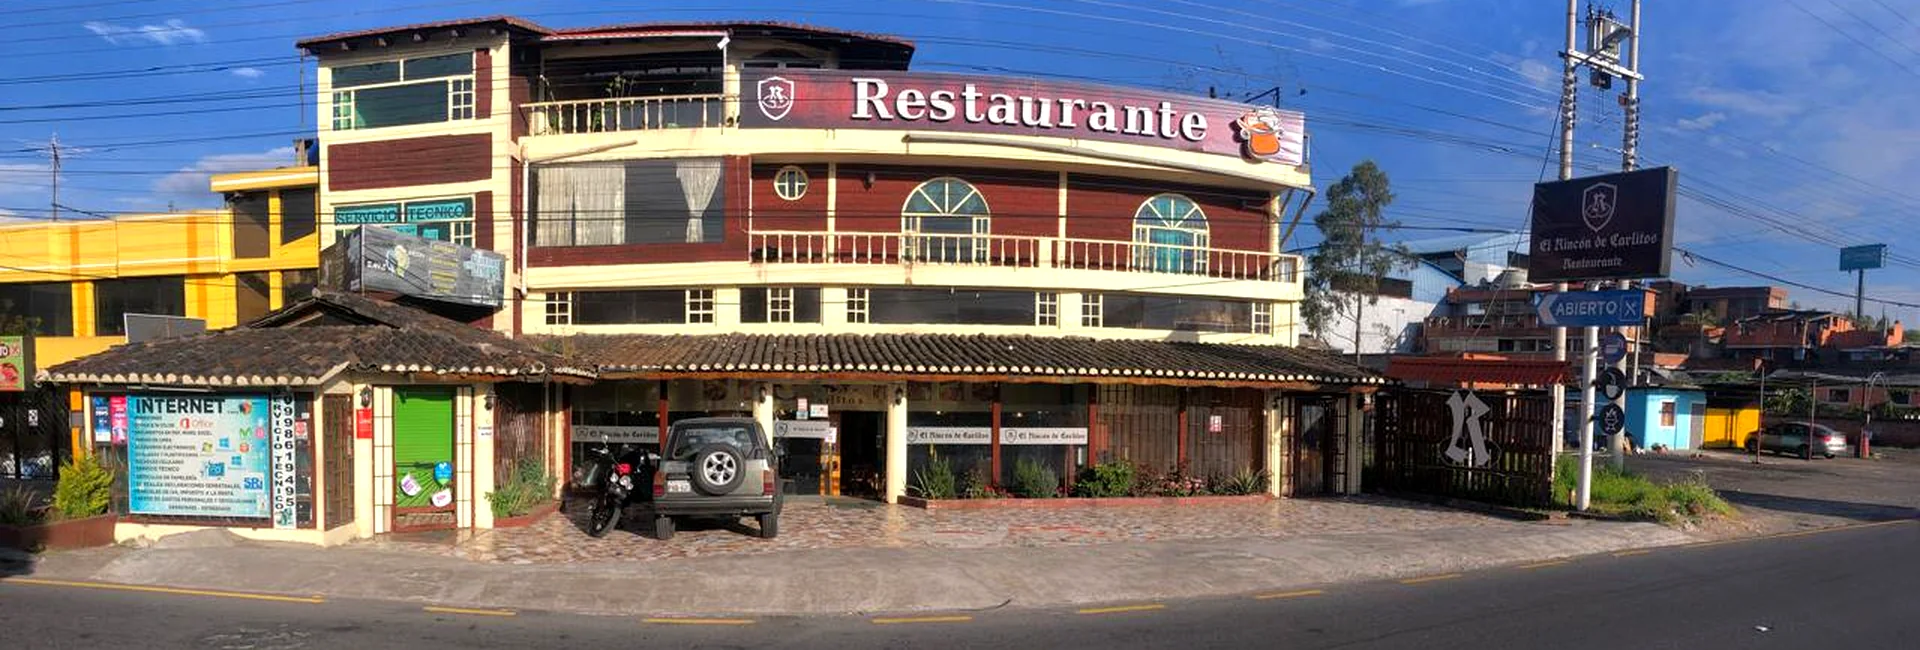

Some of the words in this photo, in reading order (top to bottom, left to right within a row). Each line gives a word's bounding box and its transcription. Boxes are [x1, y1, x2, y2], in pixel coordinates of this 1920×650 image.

[851, 77, 1208, 141] Restaurante
[336, 210, 397, 223] SERVICIO
[408, 204, 465, 221] TECNICO
[1540, 239, 1551, 251] El
[1554, 236, 1591, 251] Rincón
[1595, 236, 1608, 248] de
[1610, 231, 1657, 248] Carlitos
[1563, 257, 1623, 270] Restaurante
[1556, 302, 1618, 317] ABIERTO
[136, 399, 226, 414] INTERNET
[283, 393, 295, 507] 0998619495
[274, 455, 284, 510] TECNICO
